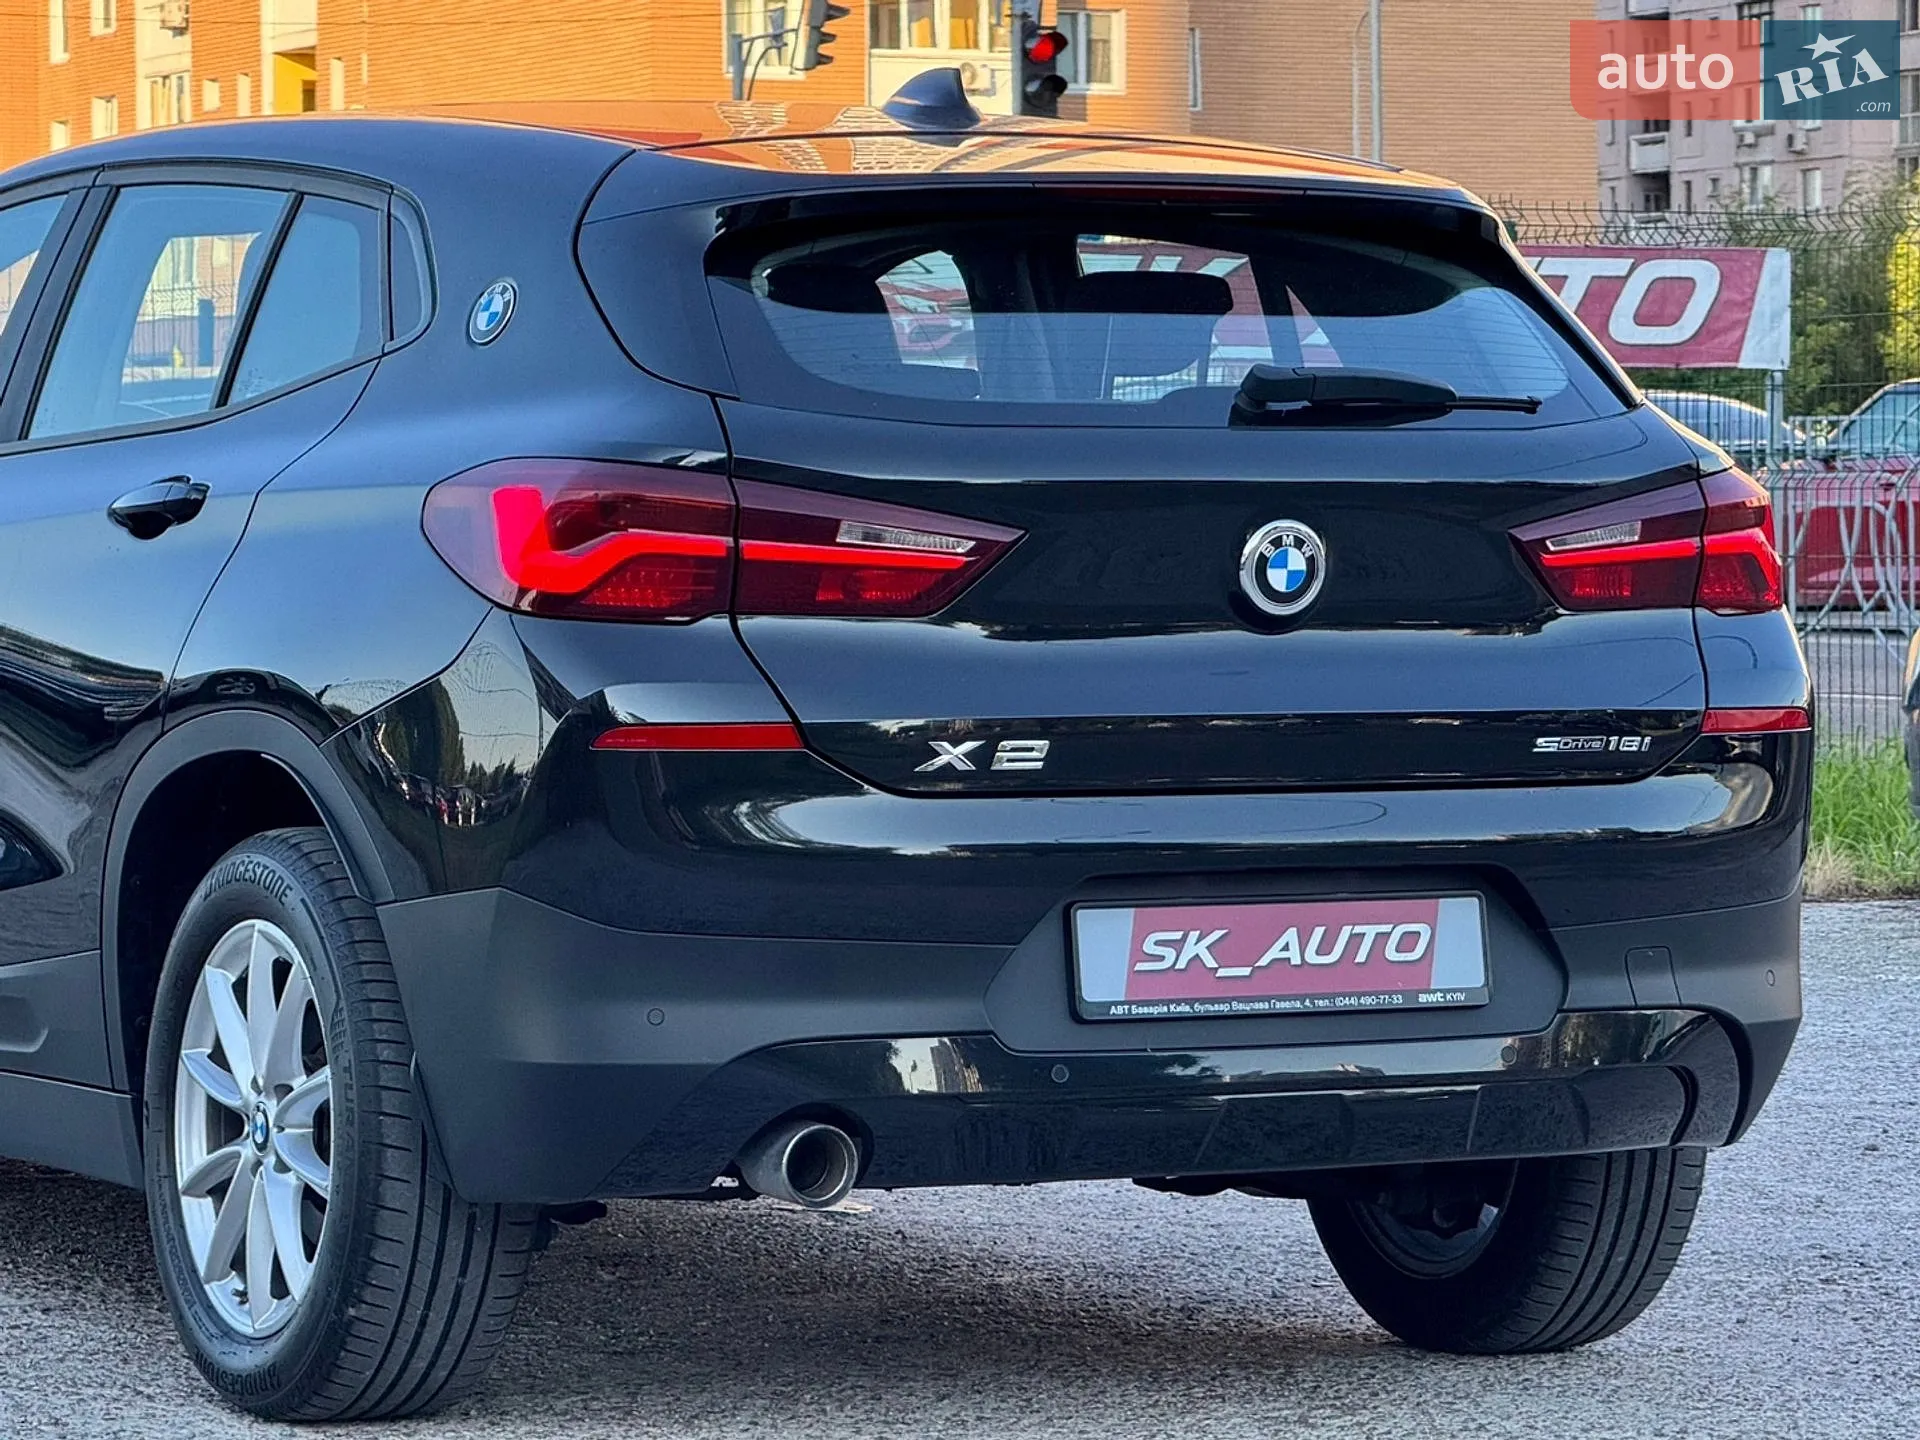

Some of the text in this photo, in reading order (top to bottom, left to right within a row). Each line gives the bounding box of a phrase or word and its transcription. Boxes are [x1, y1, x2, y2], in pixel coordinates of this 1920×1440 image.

[1522, 256, 1722, 346] TO
[1261, 534, 1314, 558] BMW
[1134, 922, 1432, 978] SK_AUTO
[1335, 996, 1358, 1007] (044)
[1360, 994, 1403, 1005] 490-77-33
